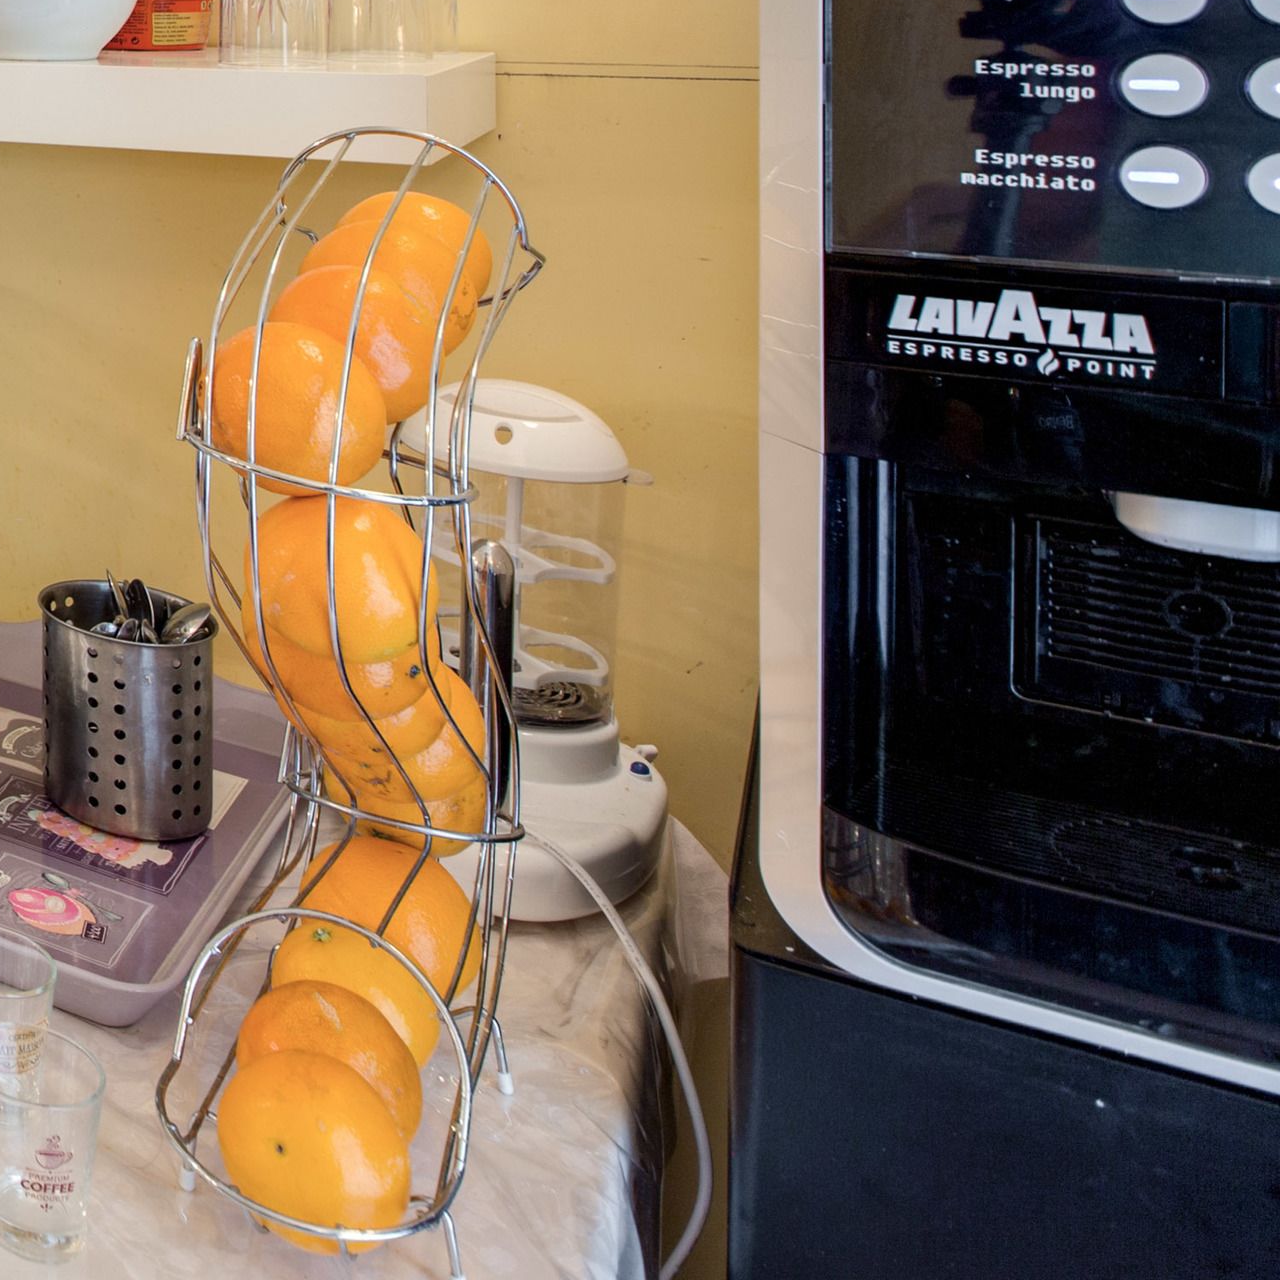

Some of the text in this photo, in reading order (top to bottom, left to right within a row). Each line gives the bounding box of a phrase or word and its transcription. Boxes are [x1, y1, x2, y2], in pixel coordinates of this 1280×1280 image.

[975, 59, 1096, 78] Espresso
[1020, 81, 1096, 101] lungo
[975, 149, 1096, 170] Espresso
[960, 170, 1096, 192] macchiato
[887, 289, 1156, 355] LAVAZZA
[888, 340, 1157, 380] ESPRESSO POINT
[21, 1180, 75, 1194] COFFEE
